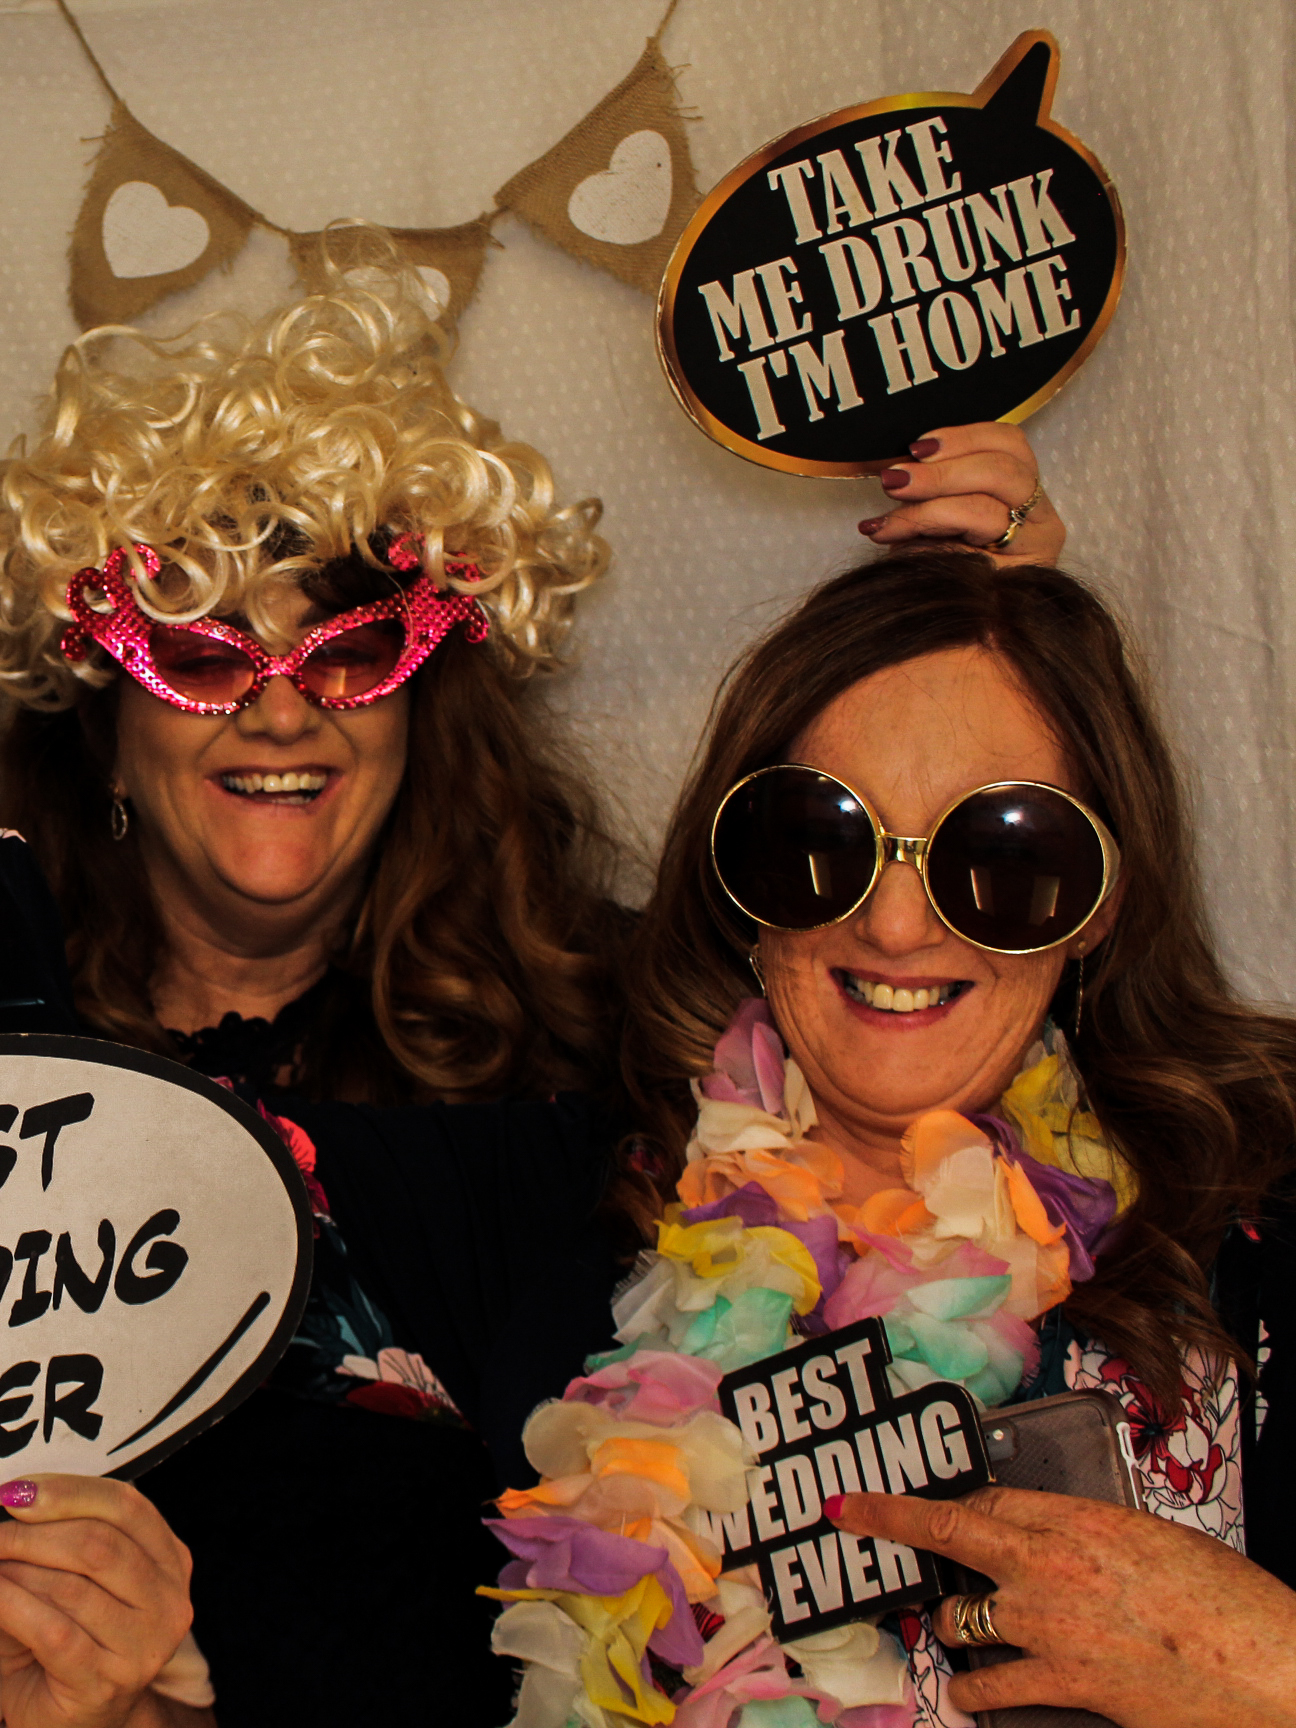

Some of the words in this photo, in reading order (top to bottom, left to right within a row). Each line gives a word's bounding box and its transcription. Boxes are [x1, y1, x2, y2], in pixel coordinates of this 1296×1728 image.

[768, 116, 962, 246] TAKE
[698, 256, 813, 363] ME
[819, 168, 1076, 322] DRUNK
[738, 329, 864, 441] I'M
[867, 254, 1081, 395] HOME
[733, 1338, 876, 1456] BEST
[770, 1529, 922, 1625] EVER
